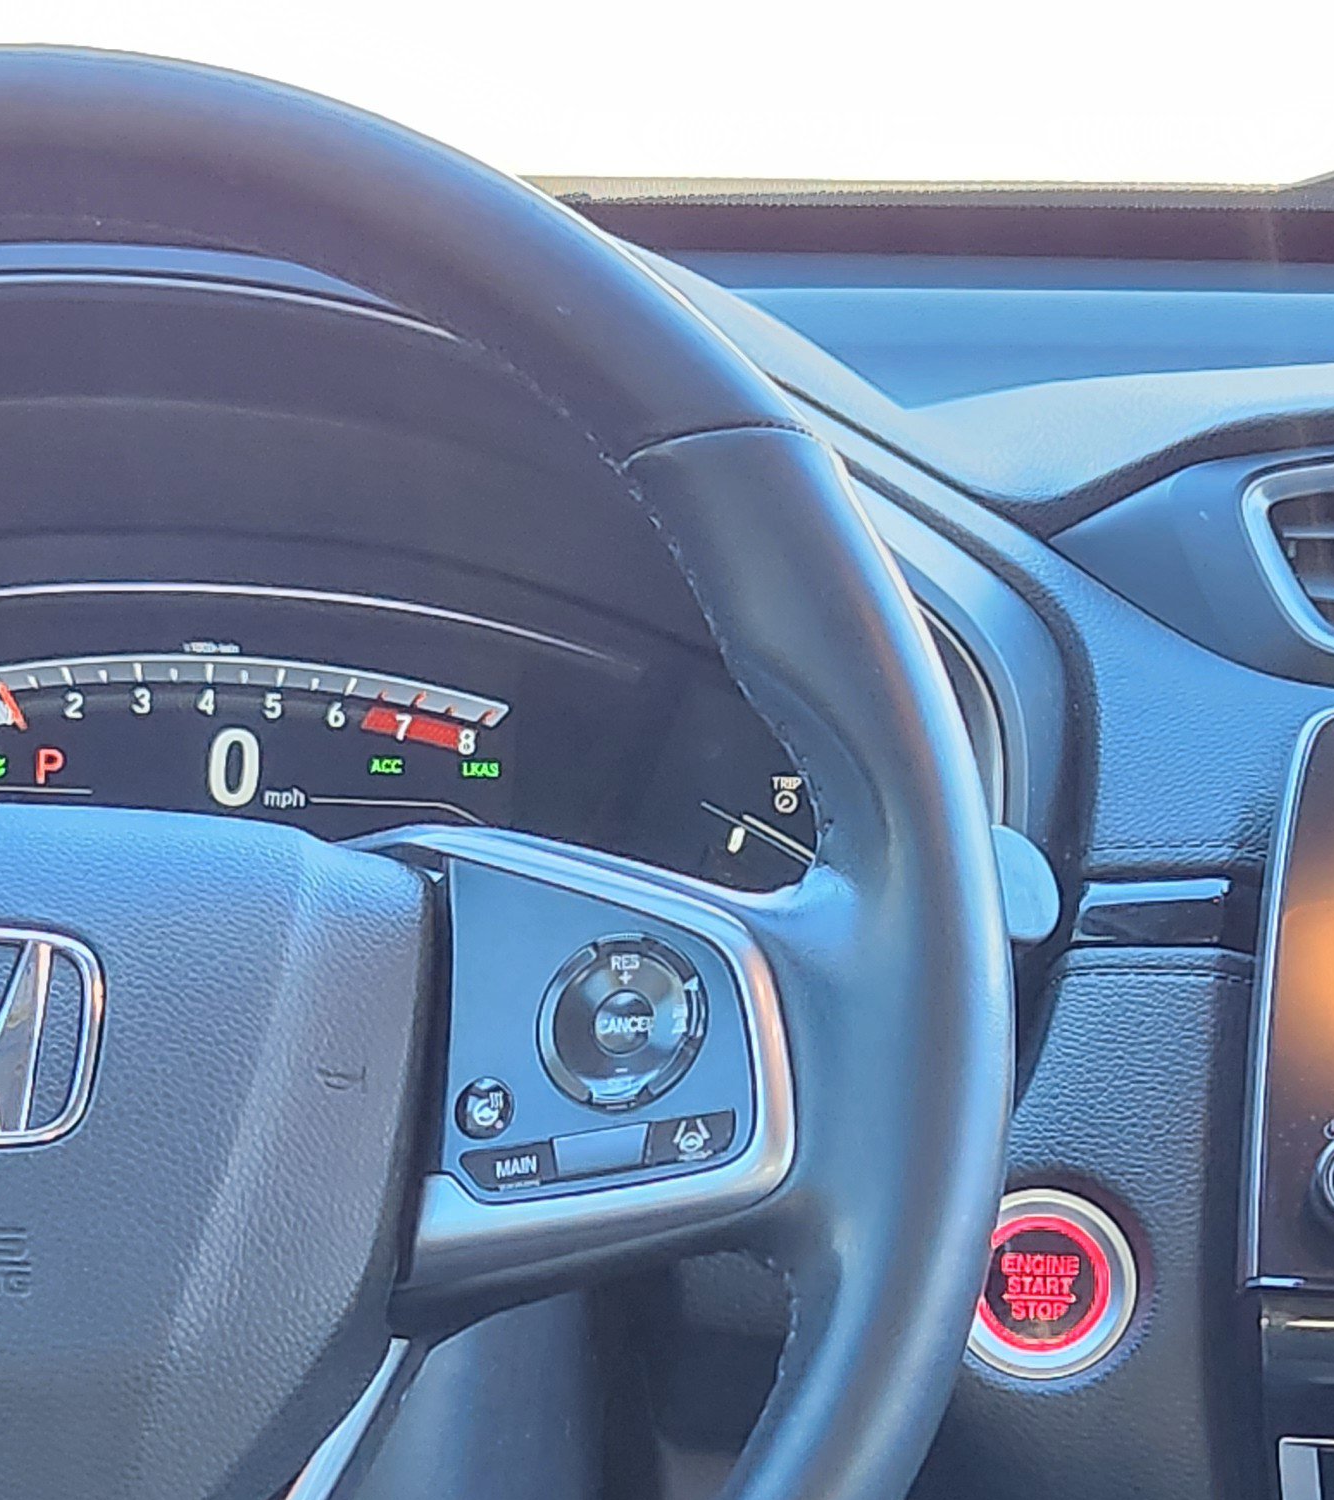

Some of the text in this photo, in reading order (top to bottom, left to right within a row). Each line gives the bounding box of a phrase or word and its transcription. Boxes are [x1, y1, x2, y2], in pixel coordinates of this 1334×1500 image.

[64, 691, 84, 719] 2
[132, 690, 151, 715] 3
[197, 690, 216, 714] 4
[264, 692, 282, 719] 5
[327, 704, 346, 728] 6
[395, 713, 410, 741] 7
[458, 726, 476, 755] 8
[35, 748, 64, 784] P
[210, 728, 261, 807] 0
[370, 758, 403, 773] ACC
[462, 762, 499, 777] LKAS
[771, 776, 802, 790] TRIP
[264, 790, 306, 807] mph
[610, 955, 641, 970] RES
[495, 1155, 538, 1180] MAIN
[1001, 1254, 1081, 1276] ENGINE
[1007, 1277, 1074, 1295] START
[1011, 1302, 1069, 1321] STOP
